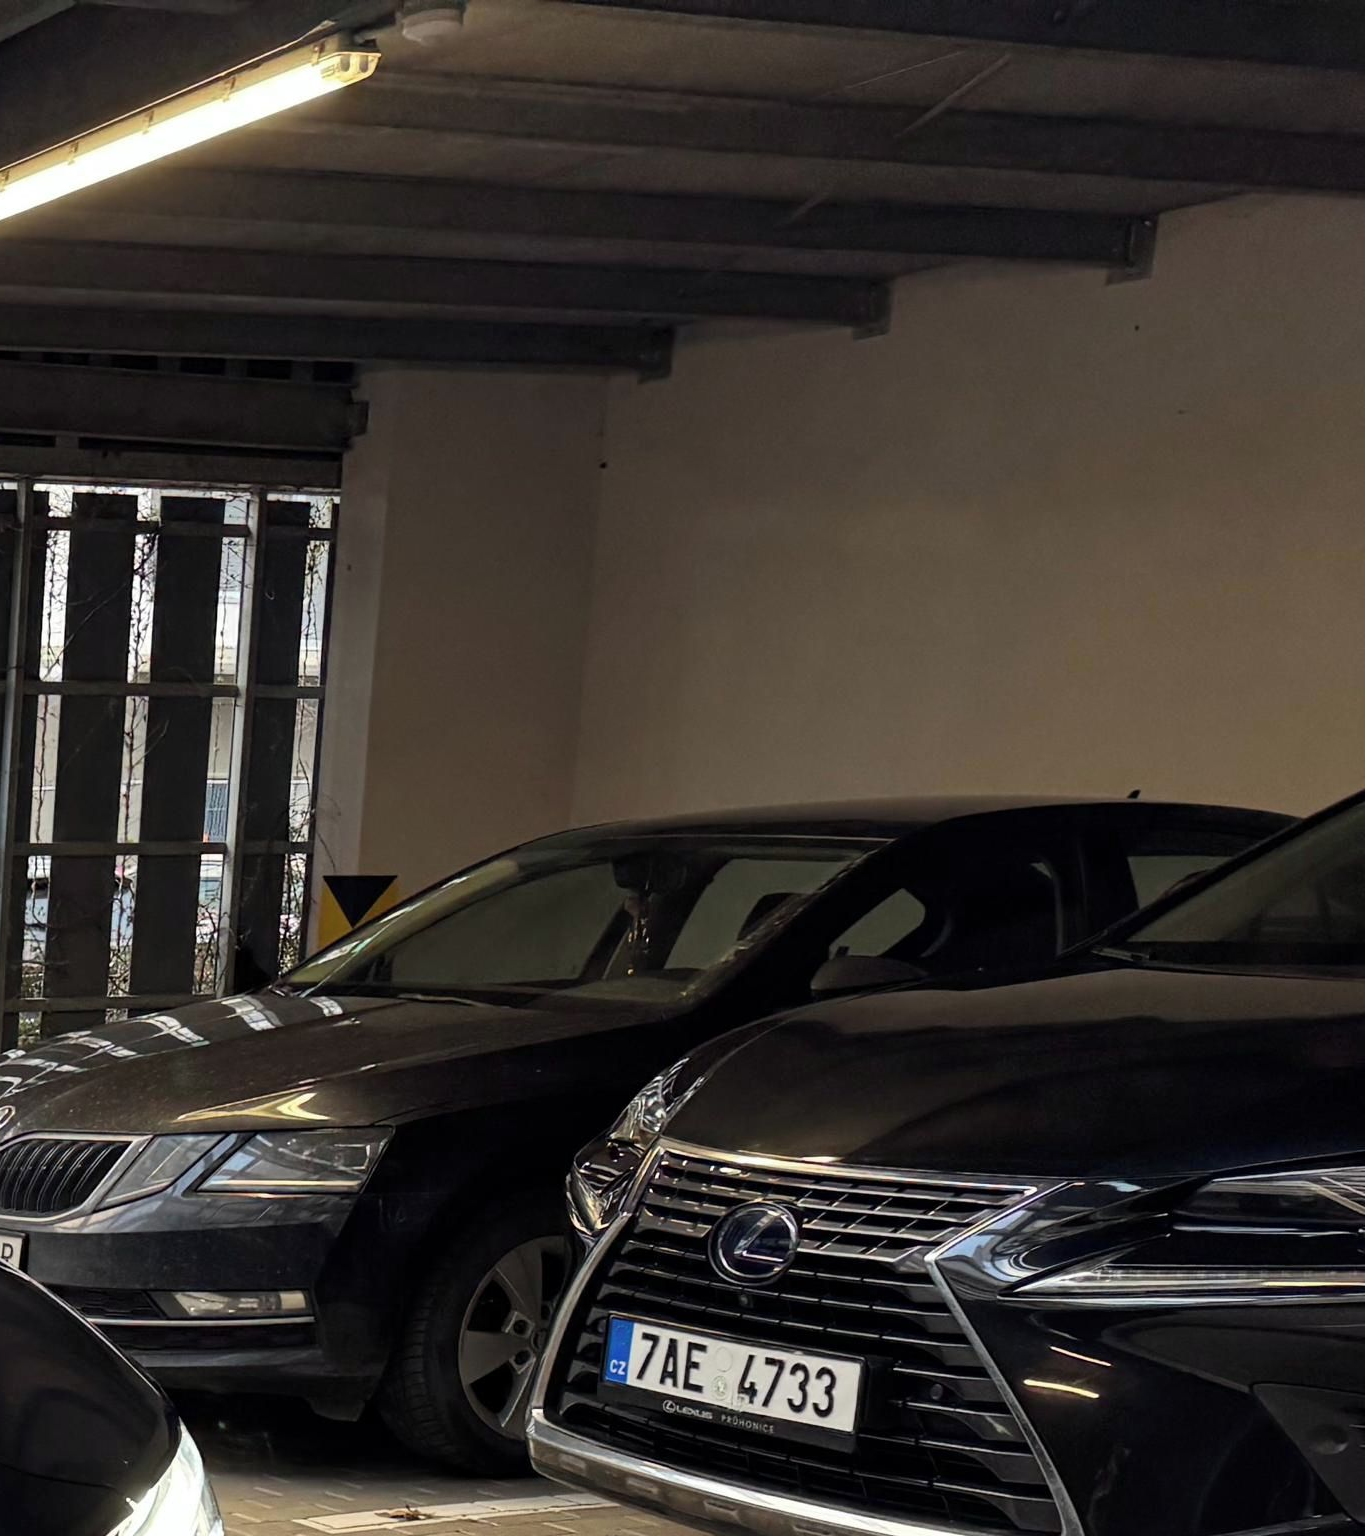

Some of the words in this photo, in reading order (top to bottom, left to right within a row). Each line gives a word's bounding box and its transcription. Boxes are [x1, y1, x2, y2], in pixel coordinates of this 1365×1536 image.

[609, 1359, 626, 1376] CZ
[636, 1332, 708, 1393] 7AE
[738, 1355, 837, 1417] 4733
